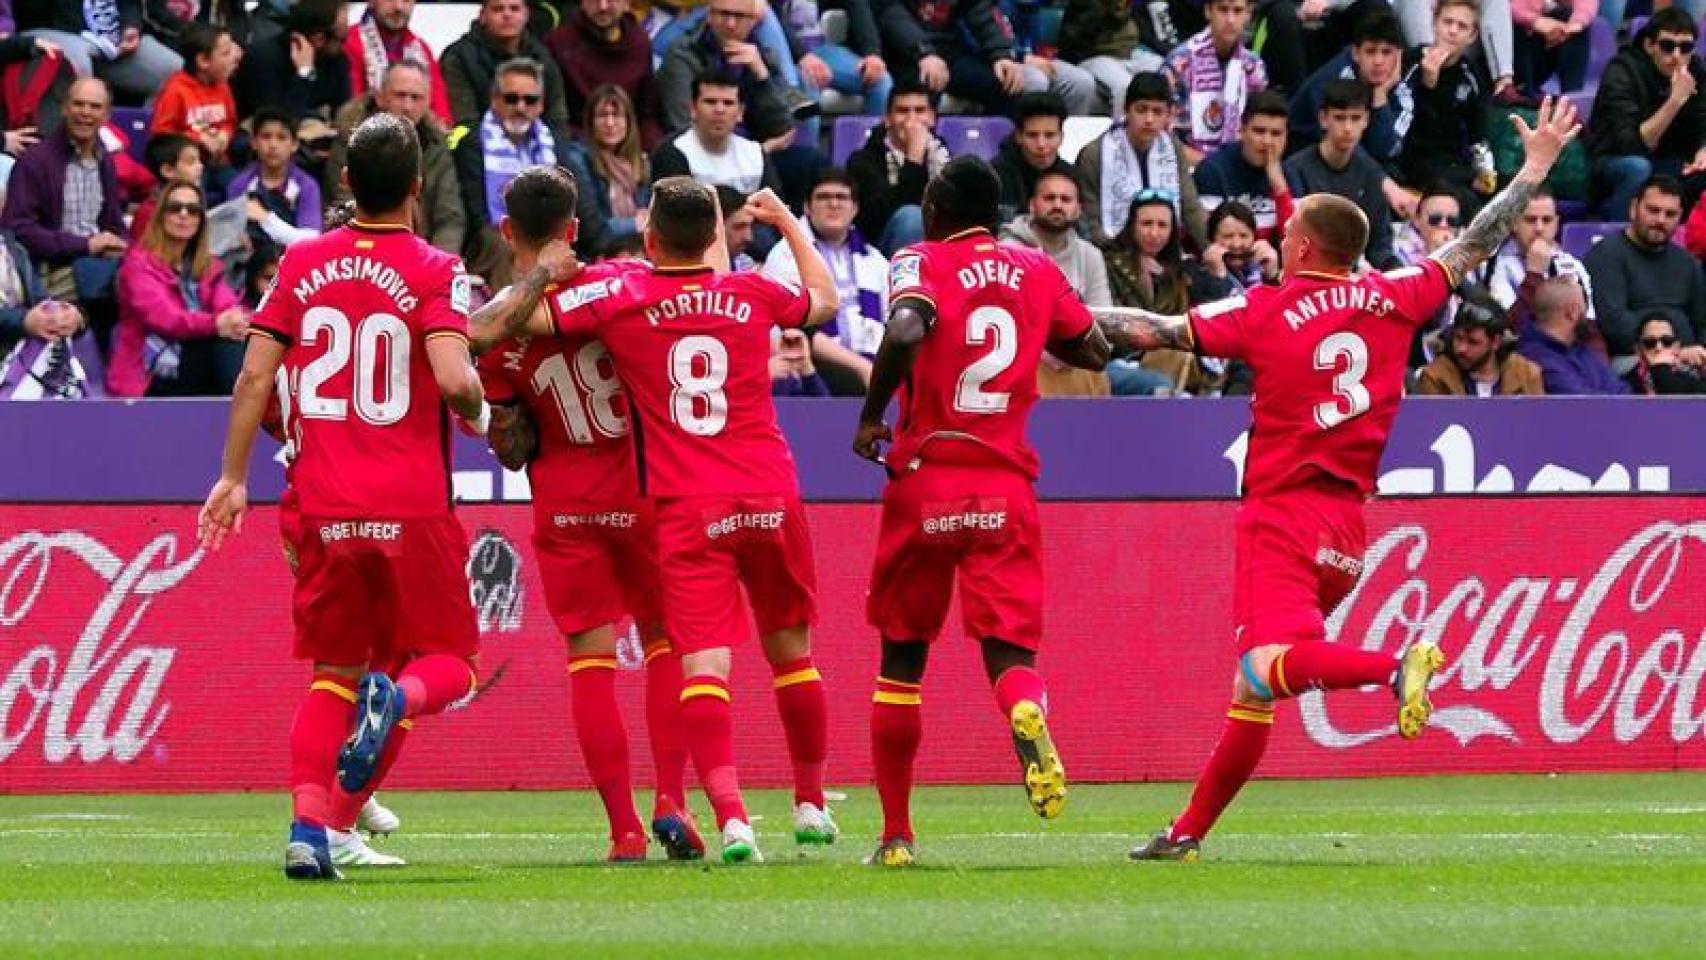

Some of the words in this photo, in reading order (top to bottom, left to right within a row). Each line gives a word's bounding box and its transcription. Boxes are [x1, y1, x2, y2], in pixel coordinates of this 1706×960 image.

[647, 290, 752, 326] PORTILLO
[958, 259, 1024, 290] DJENE
[1283, 285, 1396, 331] ANTUNES
[301, 306, 411, 426] 20
[531, 339, 632, 444] 18
[667, 334, 728, 436] 8
[954, 305, 1017, 413] 2
[1313, 331, 1371, 430] 3
[923, 511, 1007, 534] @GETAFECF
